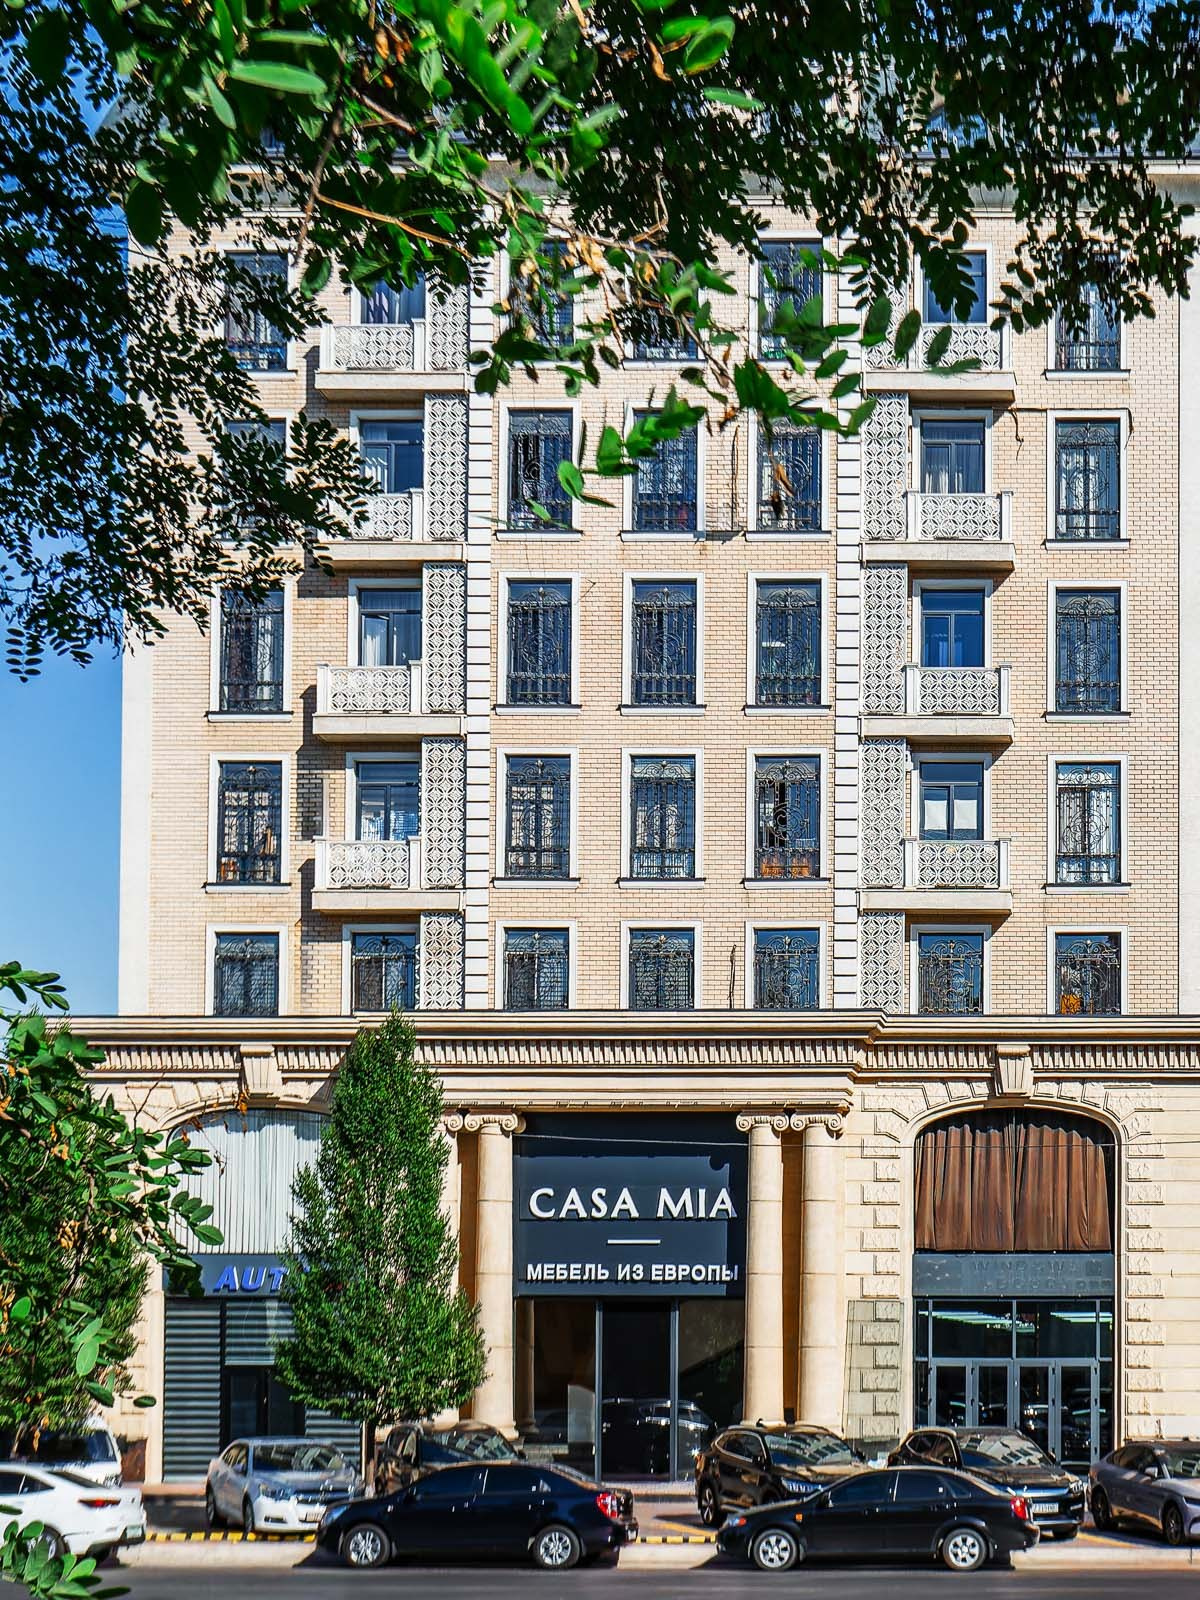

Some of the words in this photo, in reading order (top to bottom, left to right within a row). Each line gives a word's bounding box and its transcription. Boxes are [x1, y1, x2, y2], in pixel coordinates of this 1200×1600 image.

[529, 1187, 639, 1219] CASA
[656, 1187, 738, 1219] MIA
[213, 1263, 309, 1293] AUT
[526, 1263, 610, 1281] МЕБЕЛЬ
[617, 1263, 645, 1281] ИЗ
[651, 1263, 739, 1281] ЕВРОПЫ
